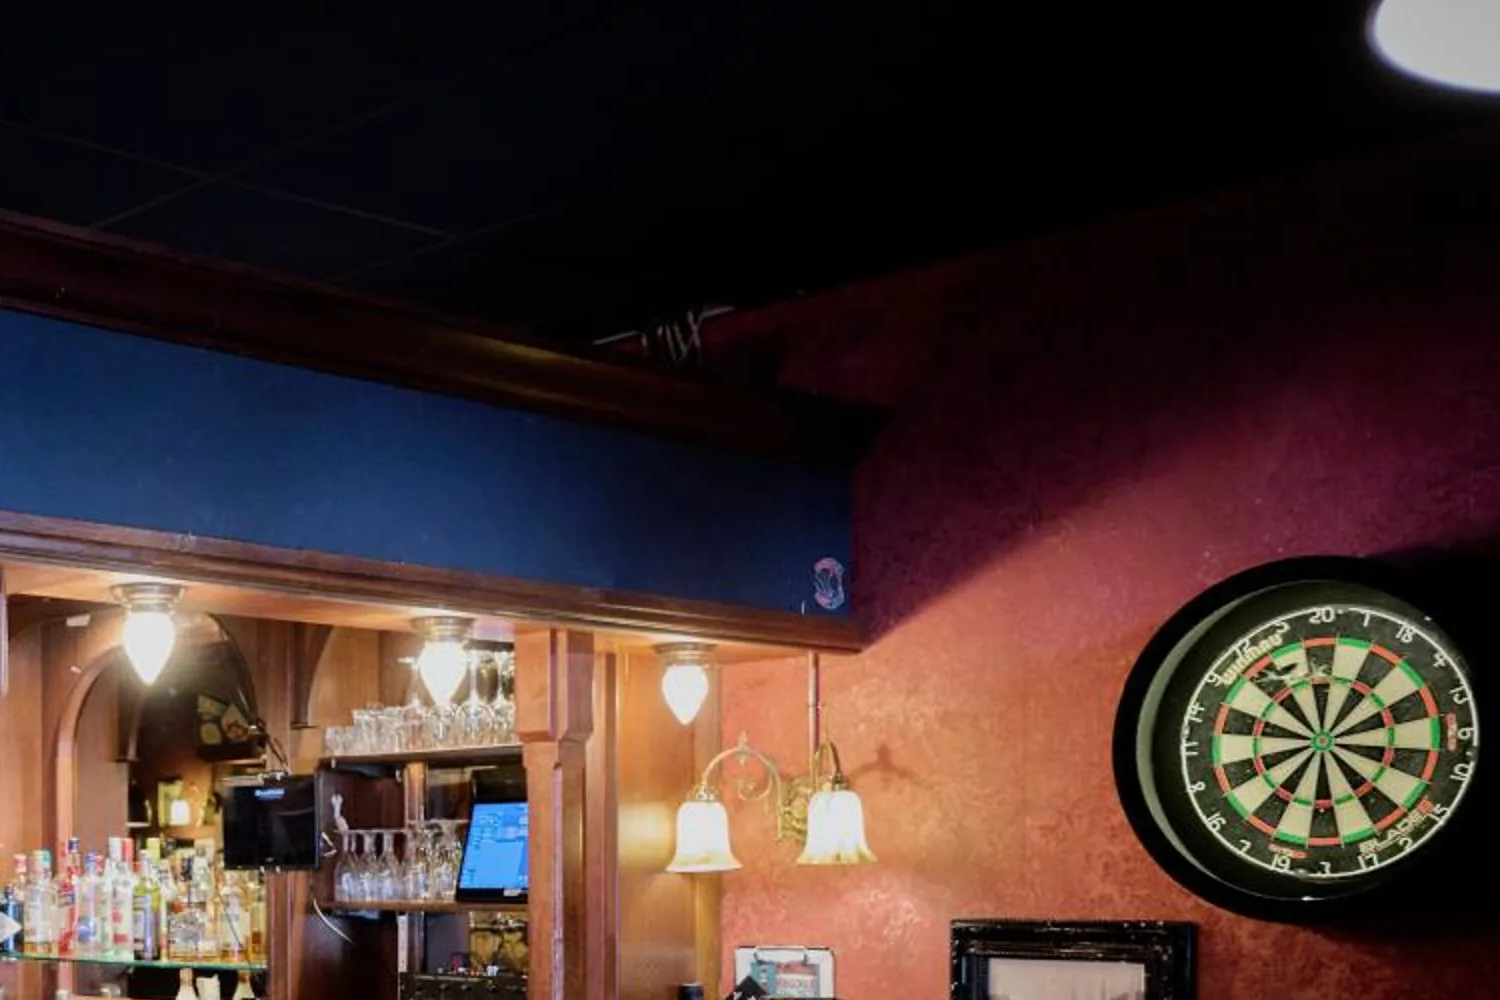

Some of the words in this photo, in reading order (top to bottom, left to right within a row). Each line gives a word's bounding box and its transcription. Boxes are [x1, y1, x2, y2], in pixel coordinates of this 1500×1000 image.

[1309, 606, 1336, 624] 20
[1395, 624, 1415, 643] 18
[1433, 652, 1447, 668] 4
[1206, 671, 1223, 688] 9
[1189, 702, 1205, 723] 14
[1450, 763, 1472, 781] 10
[1206, 812, 1227, 832] 16
